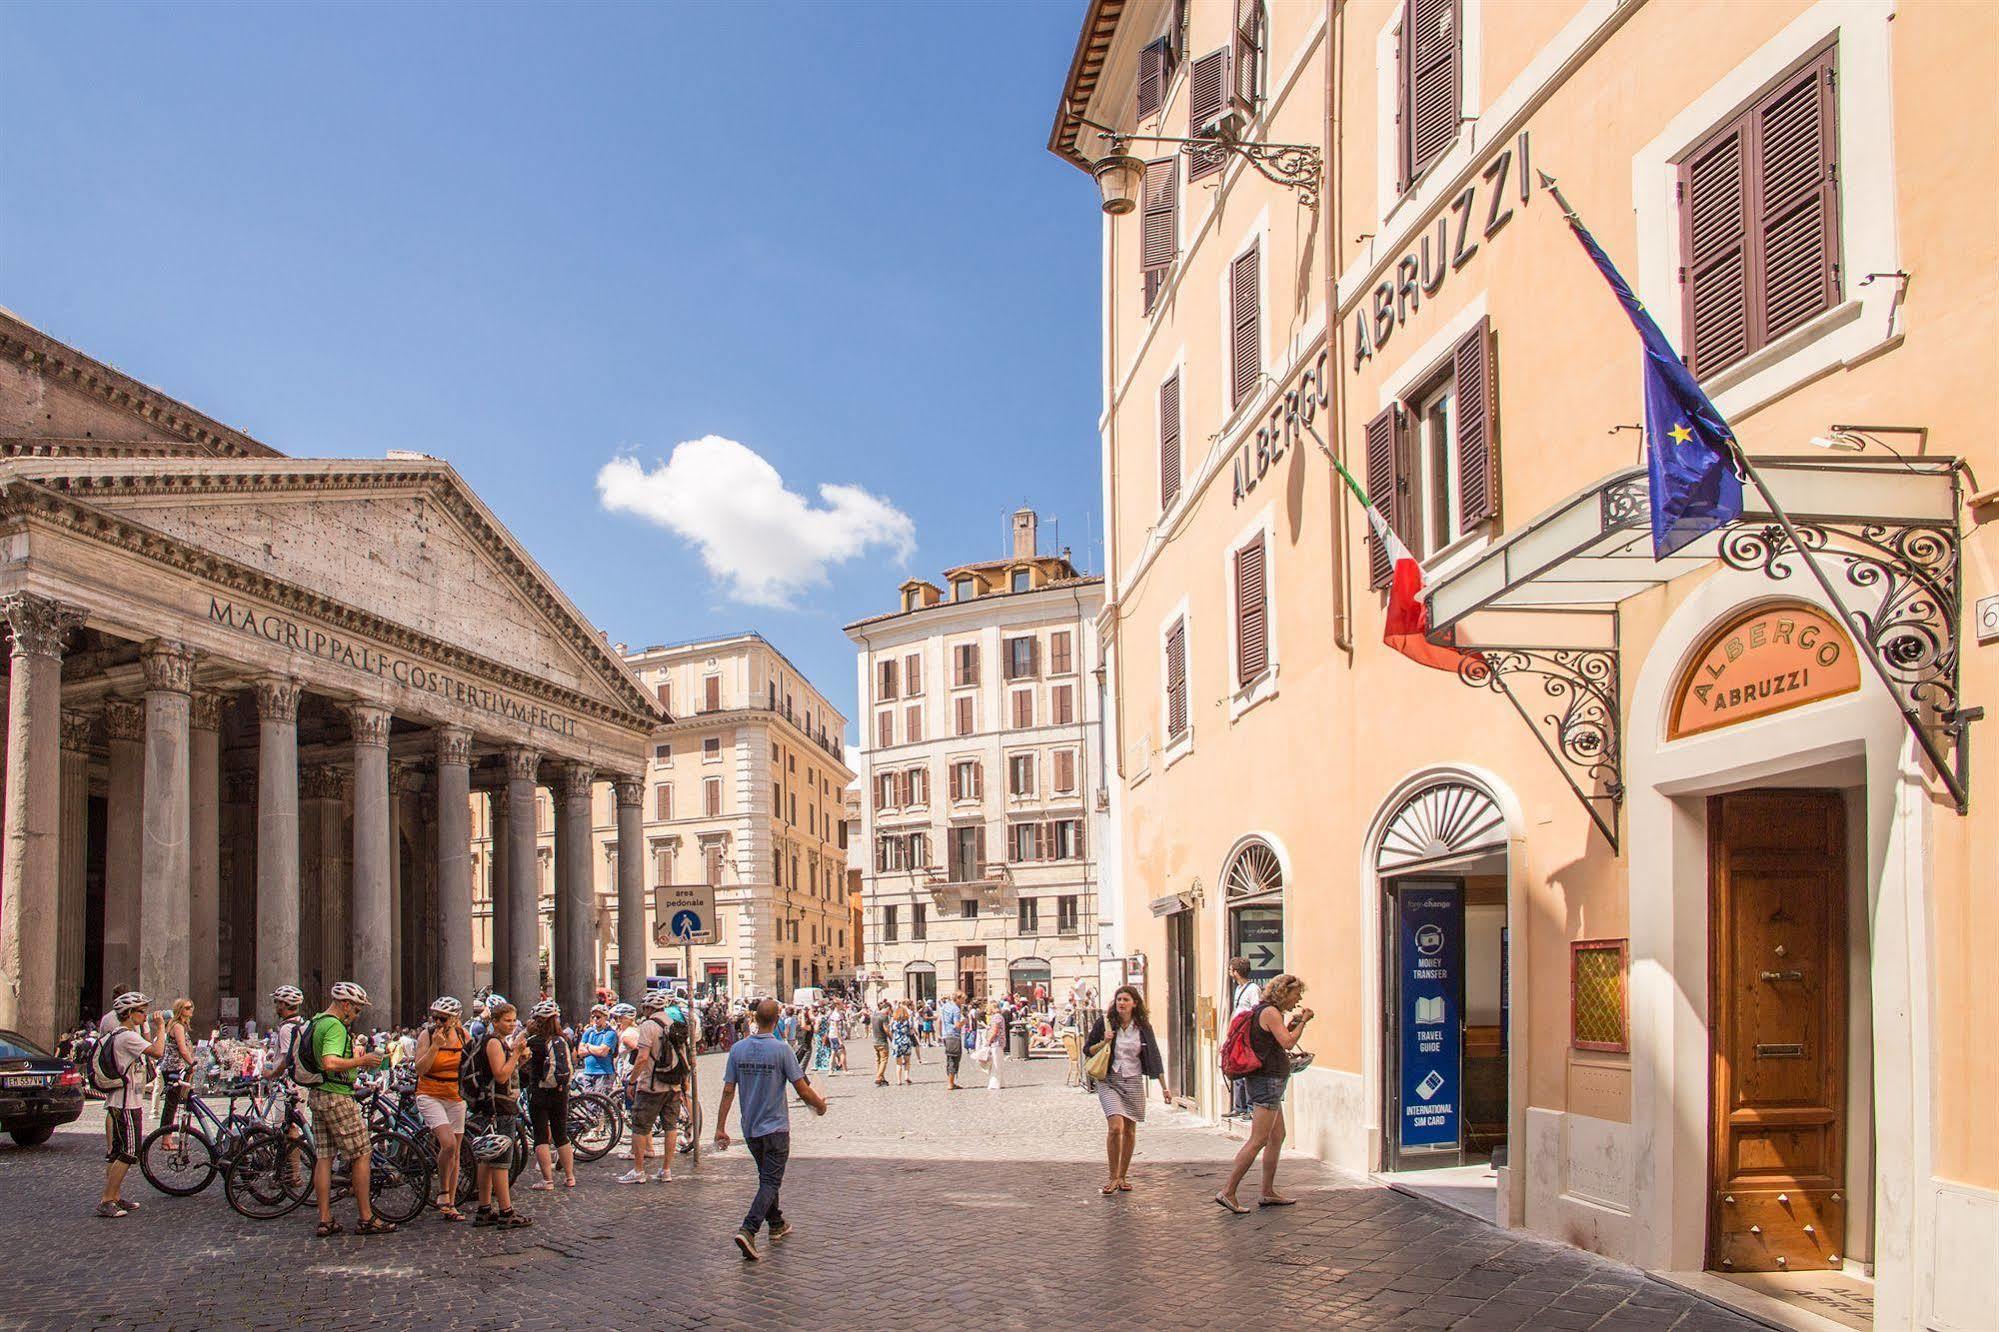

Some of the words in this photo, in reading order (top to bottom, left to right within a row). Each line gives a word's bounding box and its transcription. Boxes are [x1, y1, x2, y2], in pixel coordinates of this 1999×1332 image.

[1232, 350, 1328, 508] ALBERGO
[1353, 131, 1530, 372] ABRUZZI
[1693, 618, 1840, 705] ALBERGO
[1714, 669, 1808, 711] ABRUZZI
[666, 899, 704, 907] pedonale
[1418, 958, 1442, 968] MONEY
[1413, 969, 1447, 979] TRANSFER
[1417, 1031, 1443, 1041] TRAVEL
[1420, 1042, 1440, 1052] GUIDE
[1406, 1104, 1453, 1116] INTERNATIONAL
[1414, 1117, 1426, 1127] SIM
[1427, 1115, 1445, 1126] CARD
